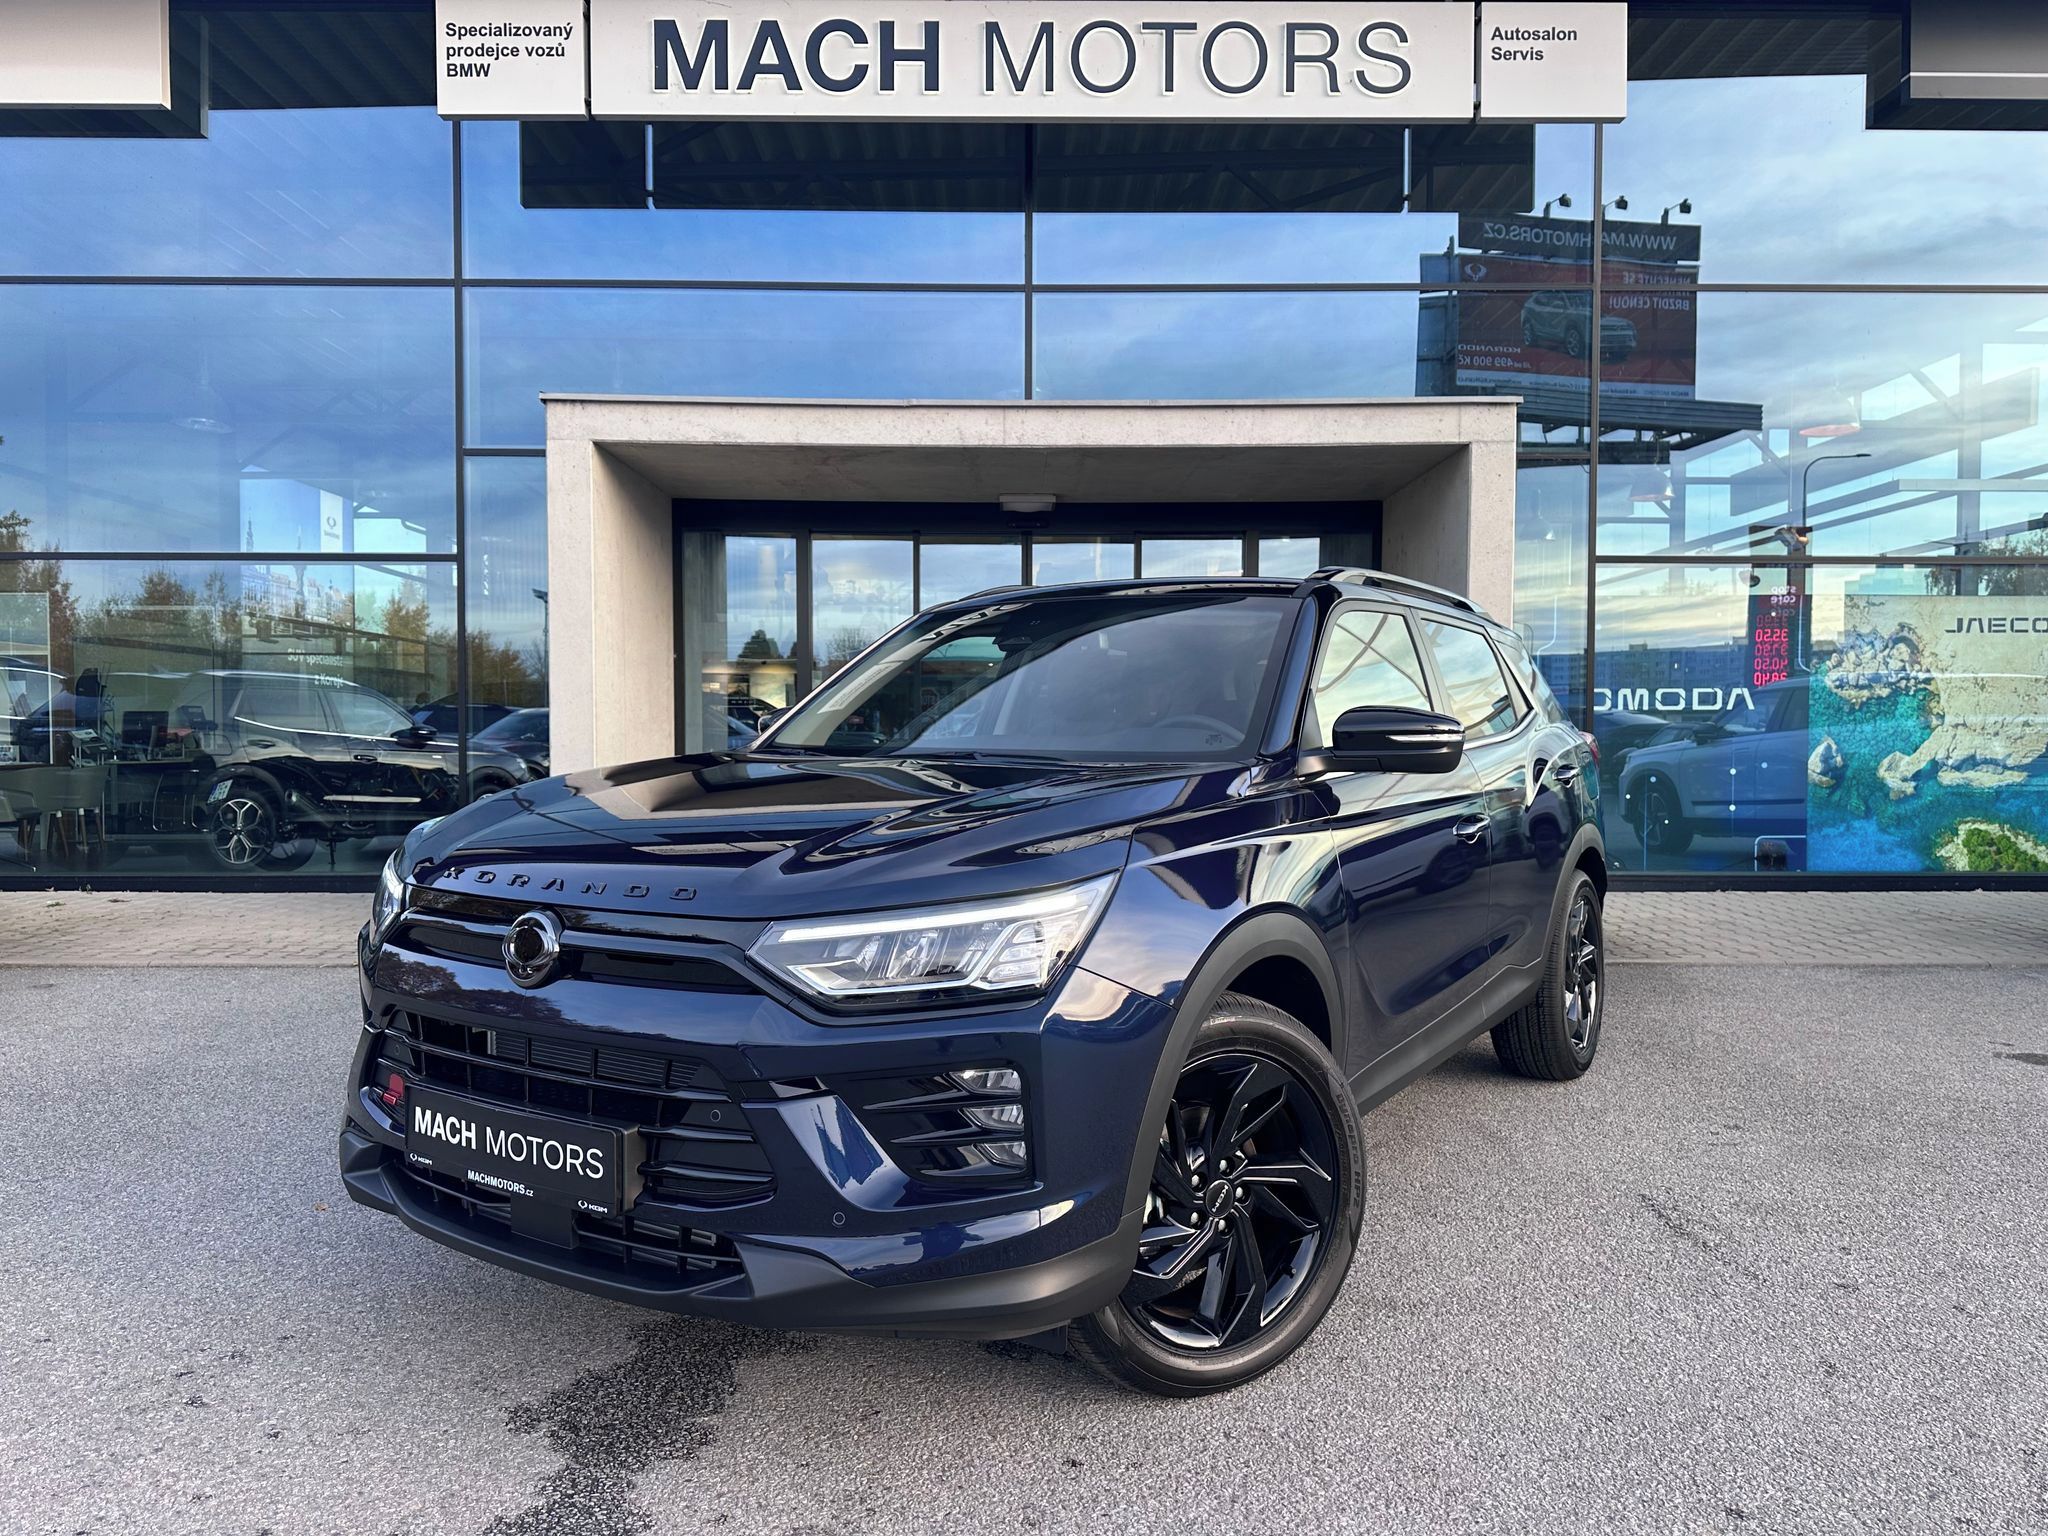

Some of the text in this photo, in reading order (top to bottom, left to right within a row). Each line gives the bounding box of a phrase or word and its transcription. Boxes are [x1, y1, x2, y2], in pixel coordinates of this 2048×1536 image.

[445, 22, 574, 40] Specializovaný
[1490, 26, 1578, 42] Autosalon
[446, 42, 566, 60] prodejce vozů
[652, 18, 1413, 95] MACH MOTORS
[1490, 46, 1545, 62] Servis
[446, 62, 491, 78] BMW
[442, 866, 698, 901] KORANDO
[414, 1106, 605, 1179] MACH MOTORS
[467, 1169, 534, 1197] MACHMOTORS.cz
[588, 1203, 608, 1214] KGM
